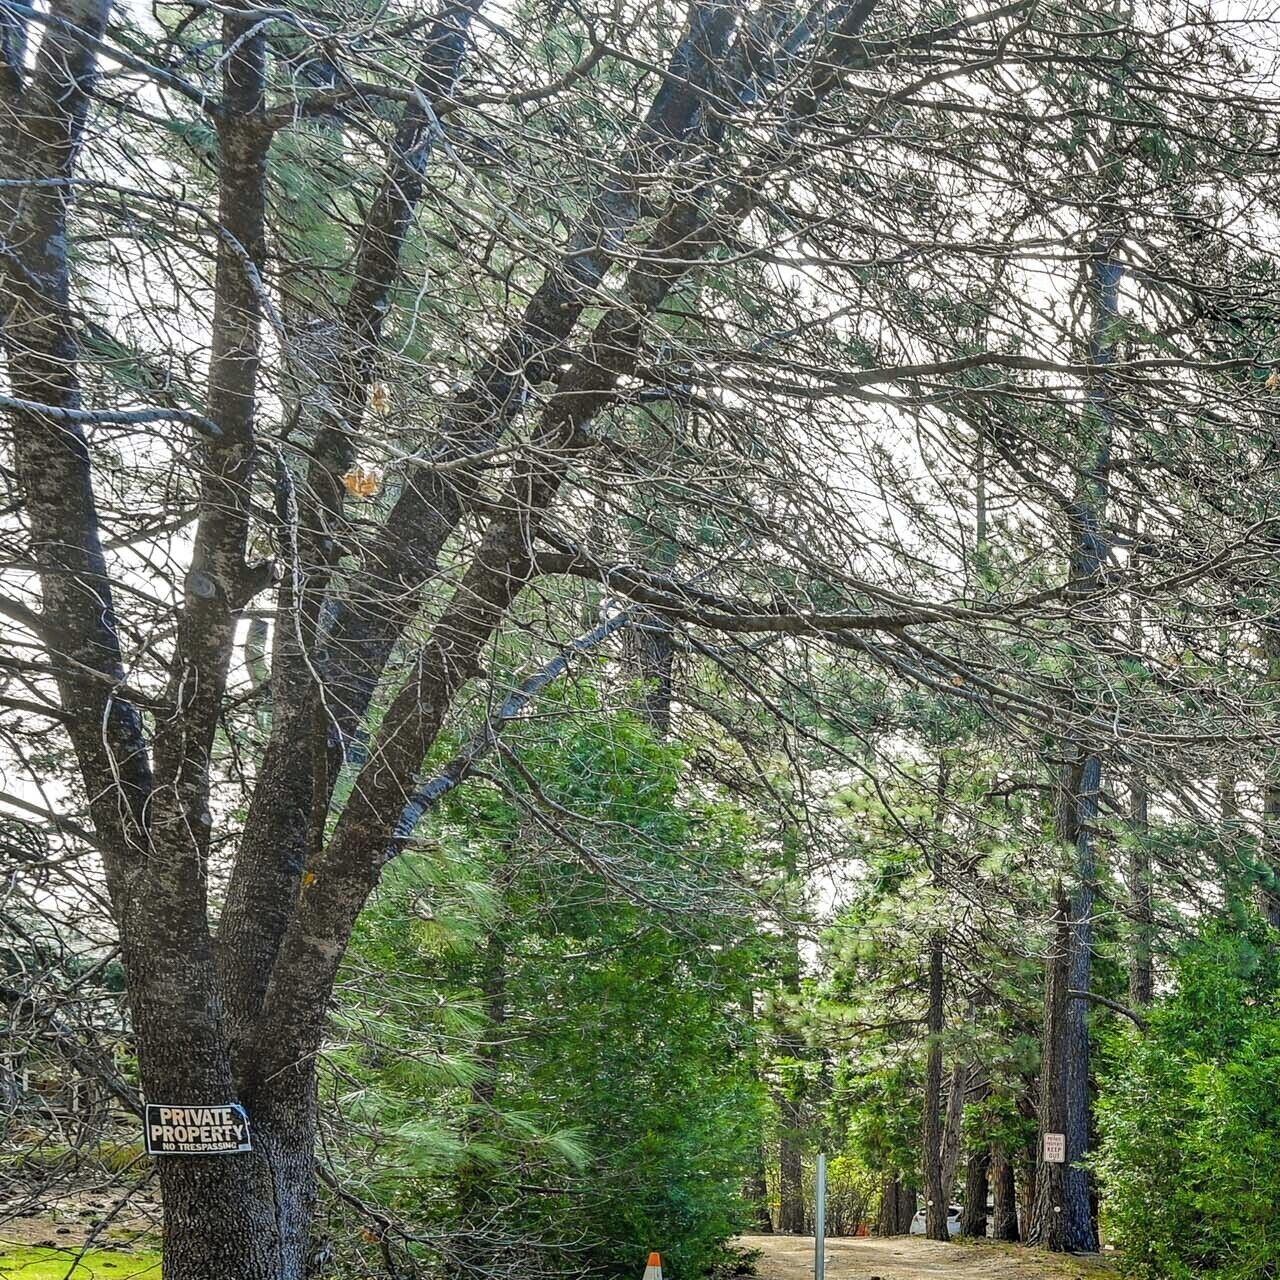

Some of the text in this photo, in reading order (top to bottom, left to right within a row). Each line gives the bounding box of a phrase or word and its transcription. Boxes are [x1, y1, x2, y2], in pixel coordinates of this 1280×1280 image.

[160, 1108, 233, 1126] PRIVATE
[151, 1125, 243, 1142] PROPERTY
[163, 1142, 237, 1151] NO TRESPASSING
